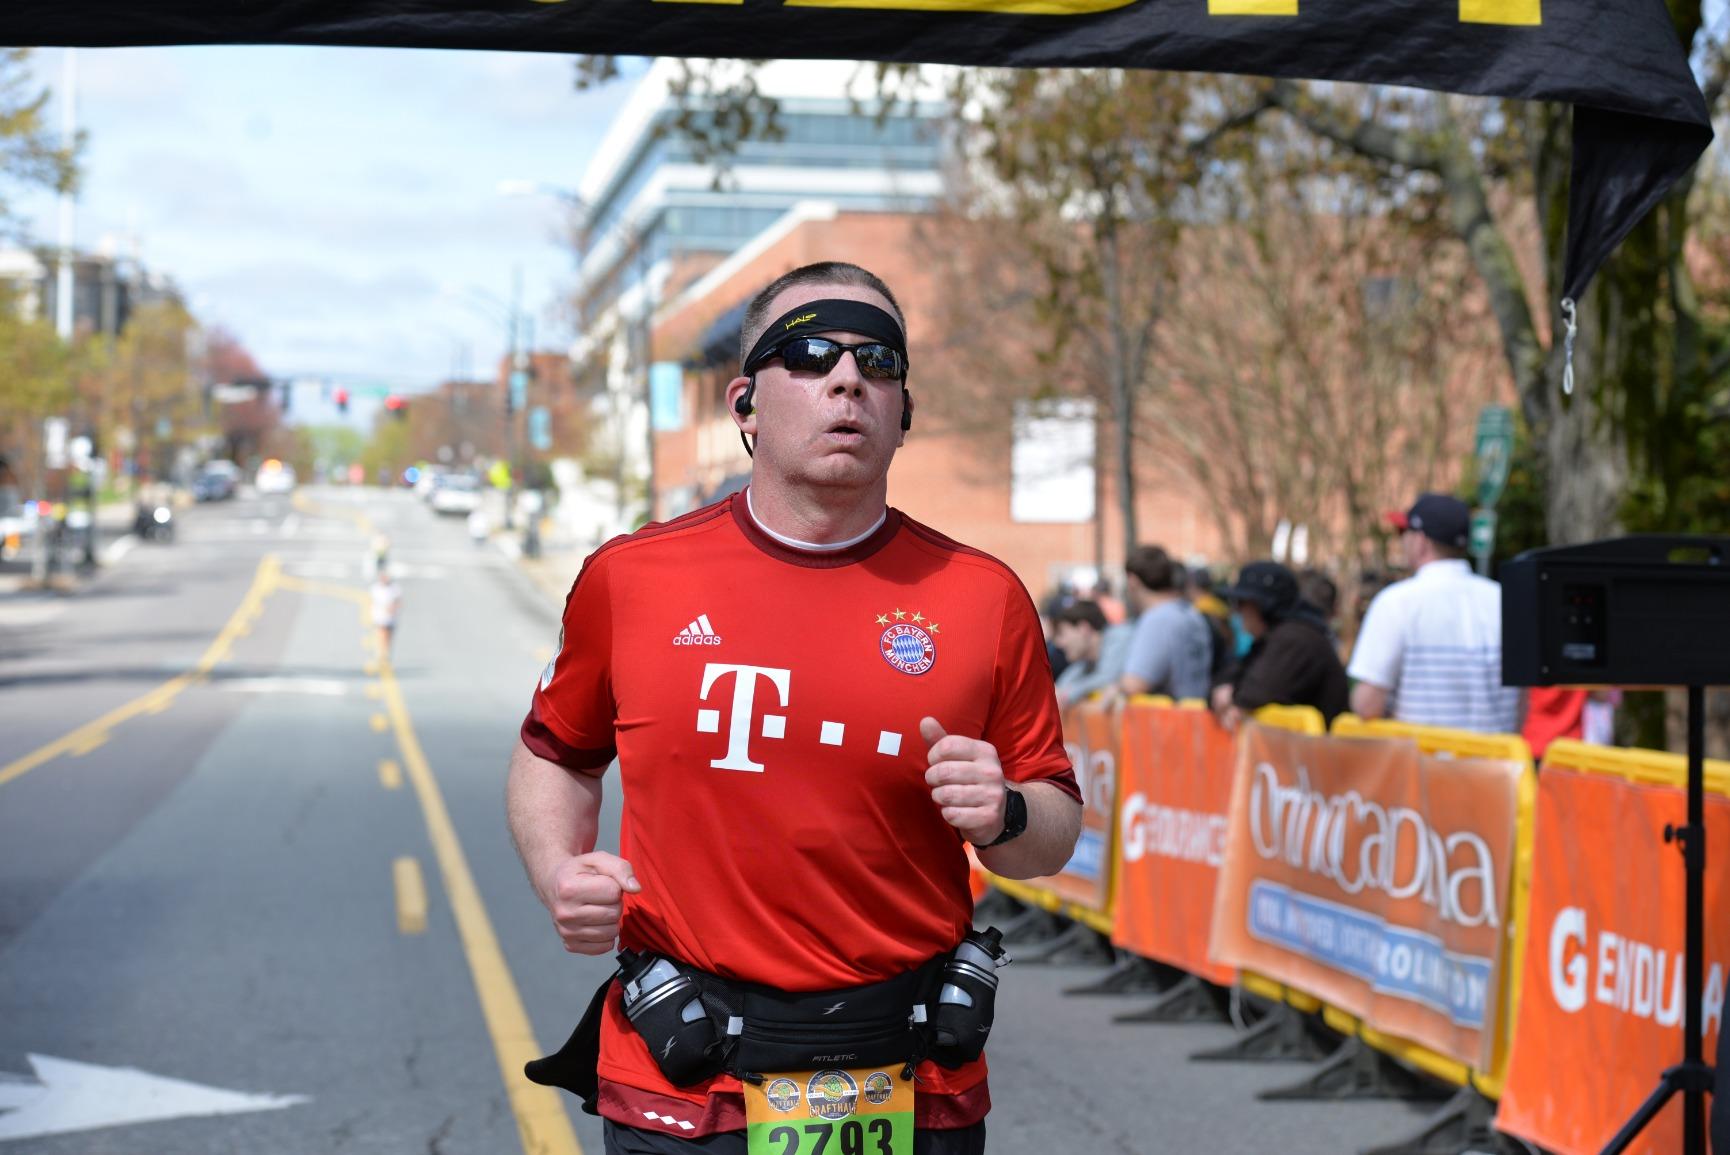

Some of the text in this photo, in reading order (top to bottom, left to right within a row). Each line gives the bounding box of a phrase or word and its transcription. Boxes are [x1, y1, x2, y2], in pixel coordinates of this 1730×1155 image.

[672, 633, 722, 646] adidas
[883, 626, 933, 652] FC BAYERN
[884, 648, 931, 673] MÜNCHEN
[1121, 791, 1147, 862] G
[1549, 906, 1588, 1014] G
[768, 1118, 893, 1155] 2793
